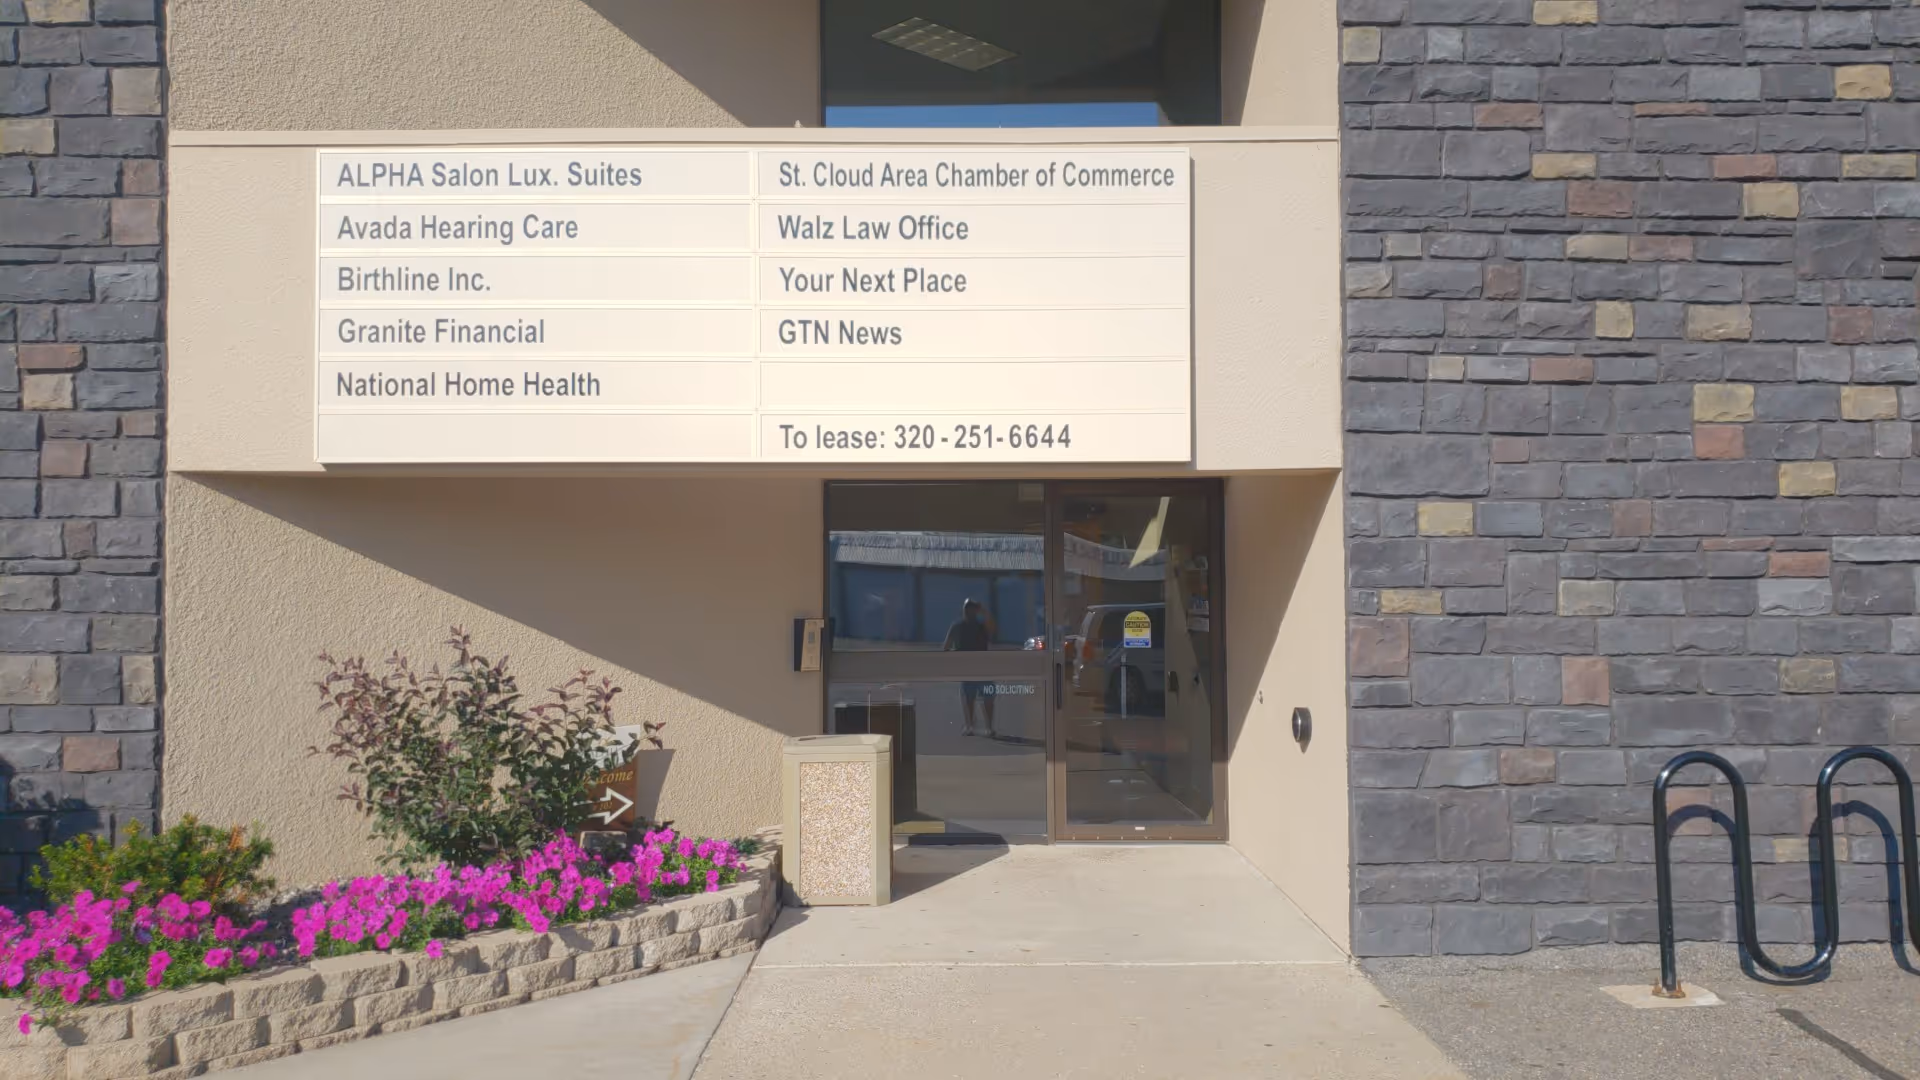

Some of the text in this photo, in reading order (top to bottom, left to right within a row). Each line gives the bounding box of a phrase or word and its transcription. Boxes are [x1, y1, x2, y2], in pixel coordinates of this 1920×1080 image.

[337, 161, 642, 187] ALPHA Salon Lux. Suites
[779, 161, 1175, 188] St. Cloud Area Chamber of Commerce
[337, 213, 579, 246] Avada Hearing Care
[778, 214, 969, 240] Walz Law Office
[338, 266, 492, 292] Birthline Inc.
[779, 267, 967, 293] Your Next Place
[338, 318, 545, 344] Granite Financial
[778, 319, 902, 346] GTN News
[337, 371, 601, 397] National Home Health
[779, 424, 808, 449] To
[816, 424, 885, 449] lease:
[983, 684, 1035, 695] NO SOLICITING
